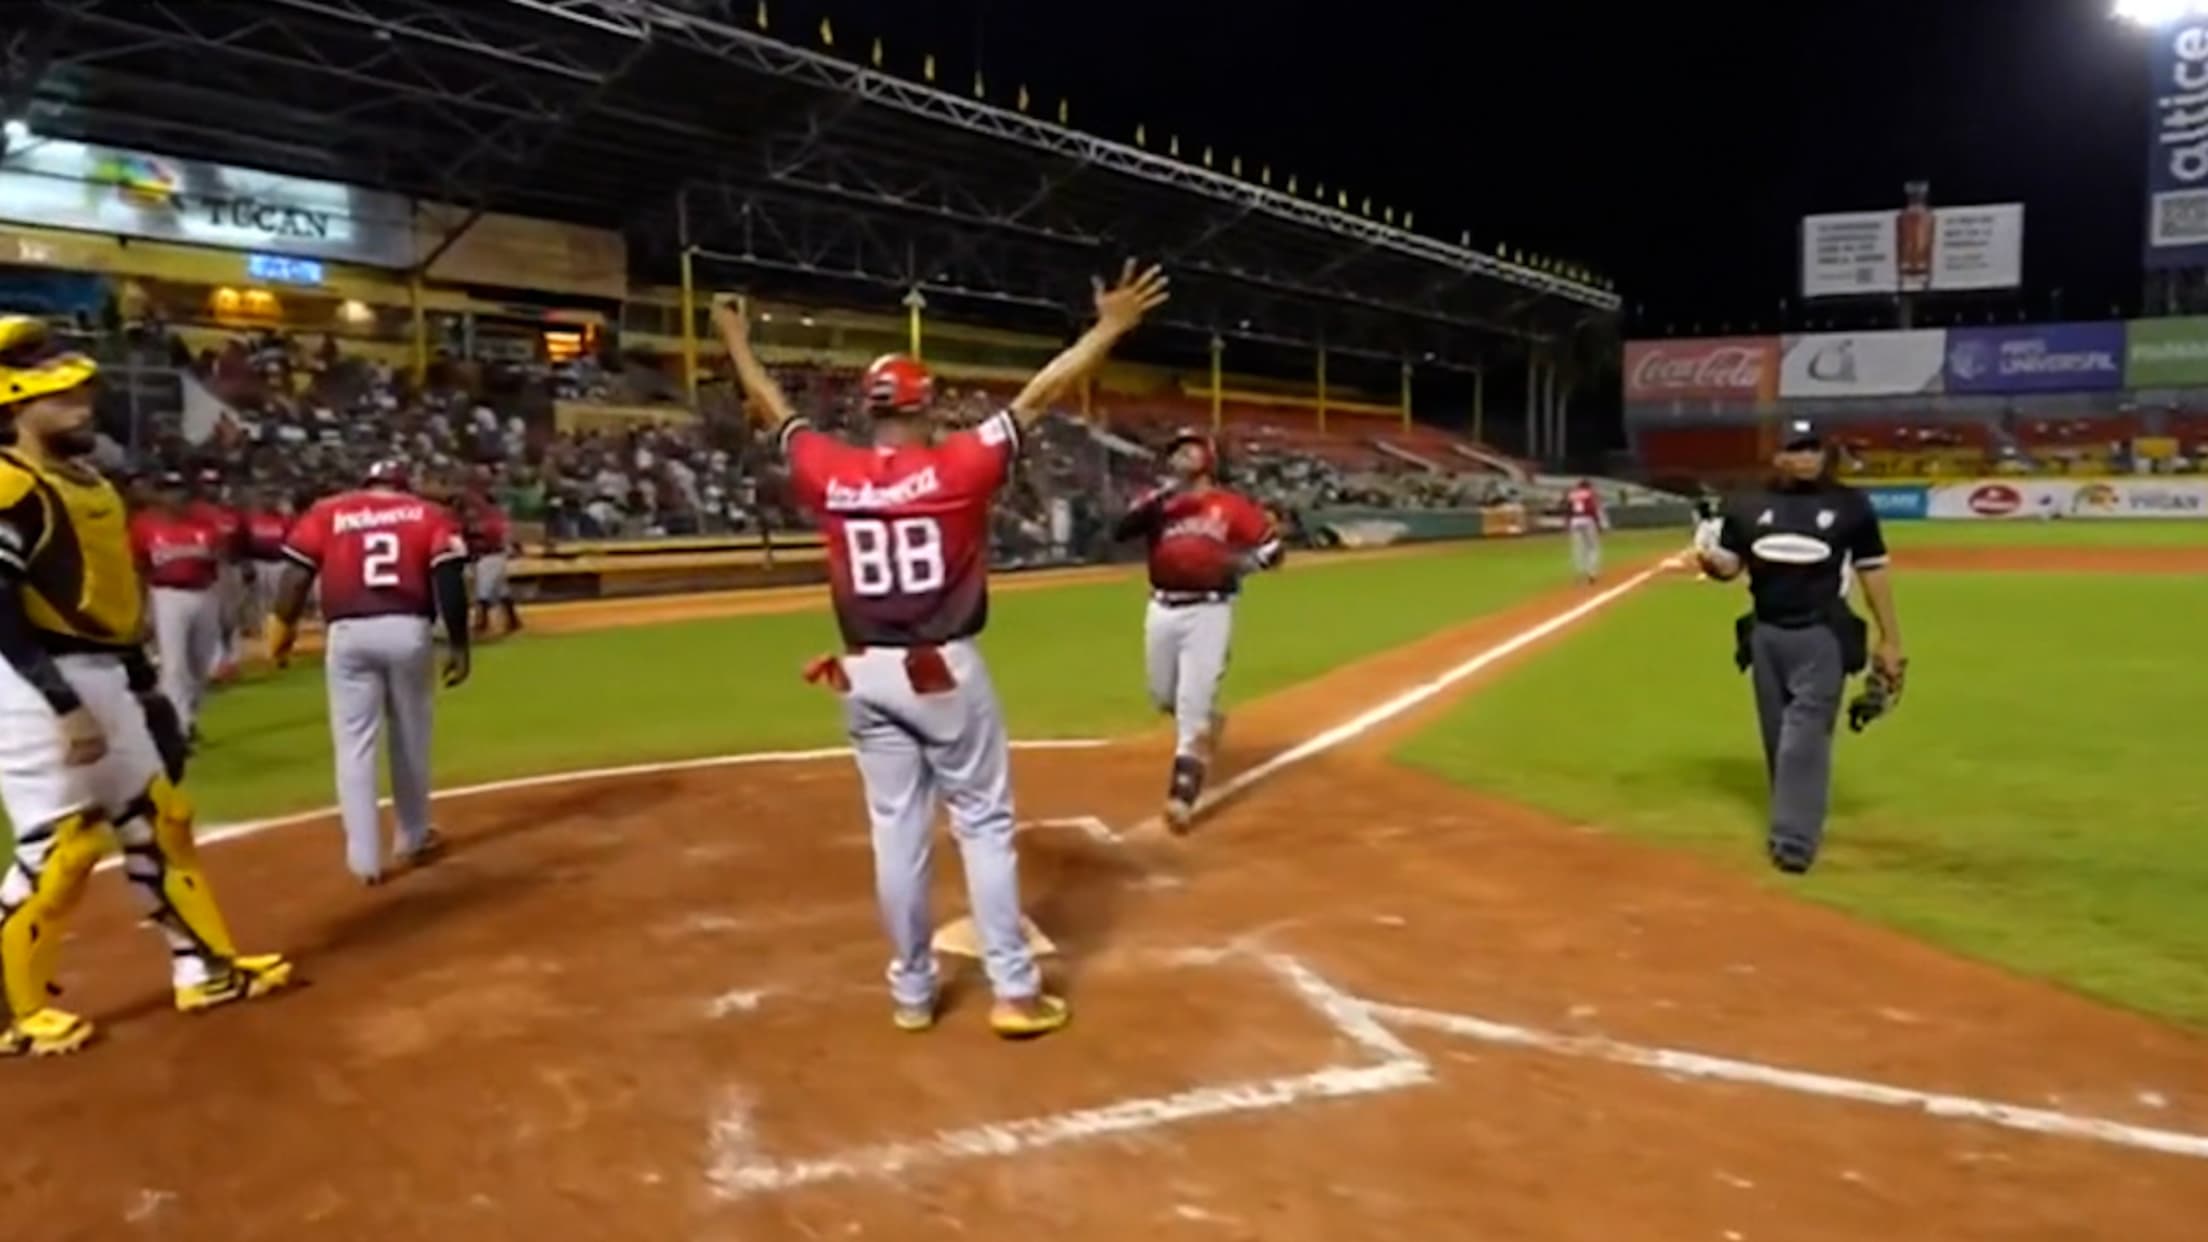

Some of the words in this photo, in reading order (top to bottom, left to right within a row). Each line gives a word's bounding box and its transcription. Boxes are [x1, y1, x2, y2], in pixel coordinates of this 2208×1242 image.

[2159, 26, 2208, 182] altice
[202, 197, 328, 239] TUCAN
[363, 531, 399, 587] 2
[843, 517, 945, 594] 88
